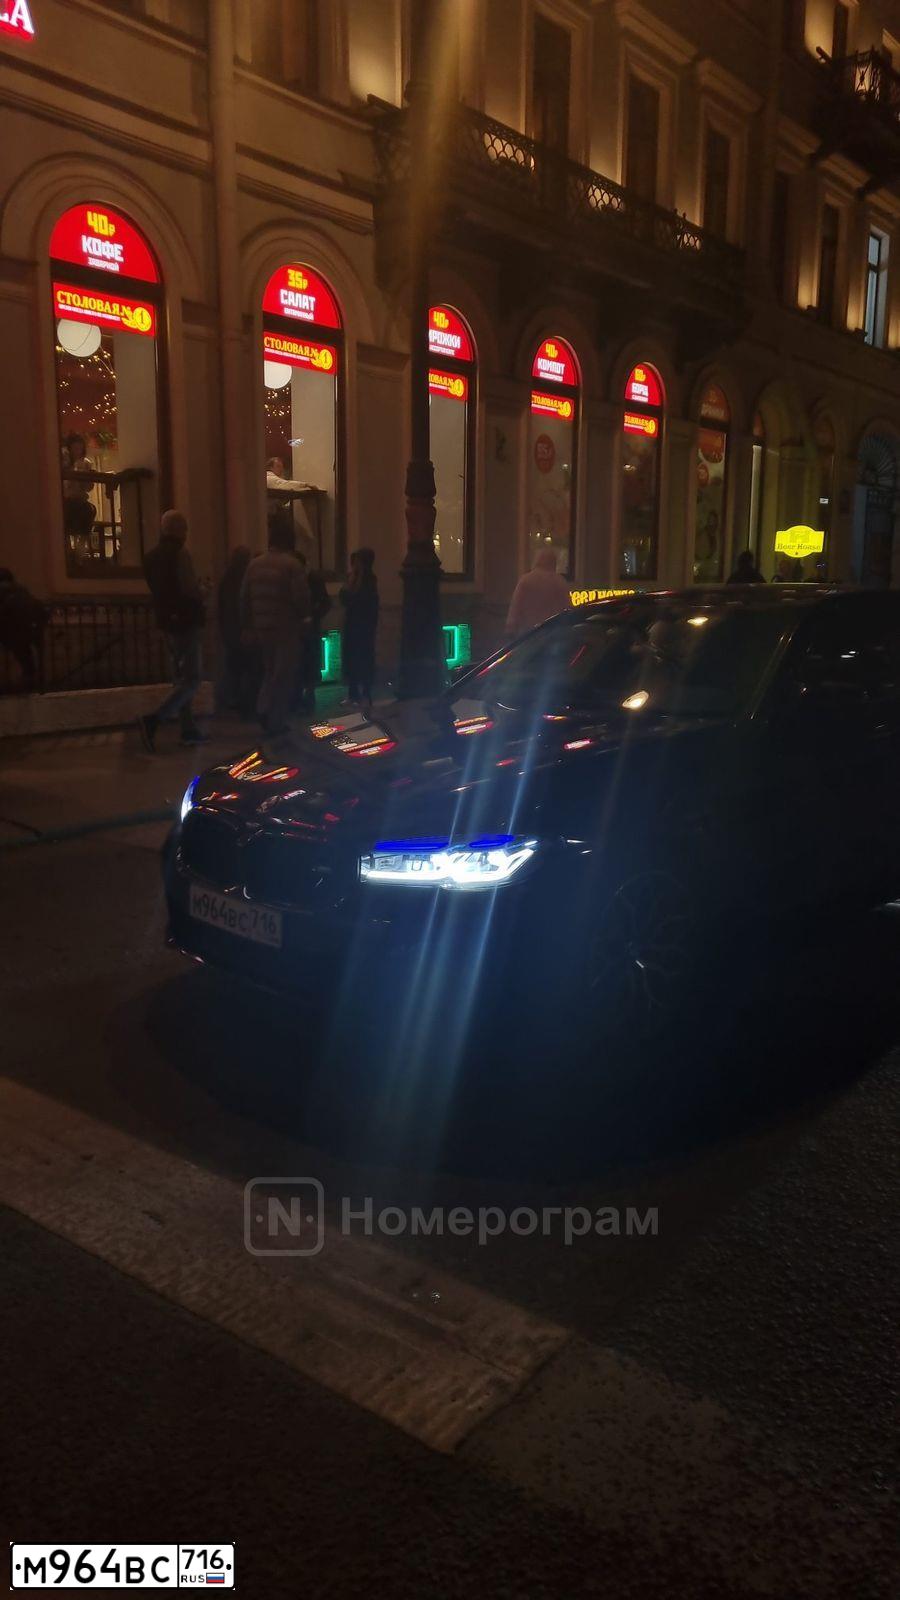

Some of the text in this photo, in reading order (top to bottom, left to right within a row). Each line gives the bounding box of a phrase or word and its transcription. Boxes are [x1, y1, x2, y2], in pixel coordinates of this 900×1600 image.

[82, 235, 124, 262] КОФЕ
[57, 290, 120, 315] СТОЛОВАЯ
[280, 288, 316, 311] САЛАТ
[264, 336, 310, 357] СТОЛОВАЯ
[429, 329, 461, 349] ИРОЖКИ
[538, 357, 565, 375] КОМПОТ
[429, 372, 448, 387] ОВАЯ
